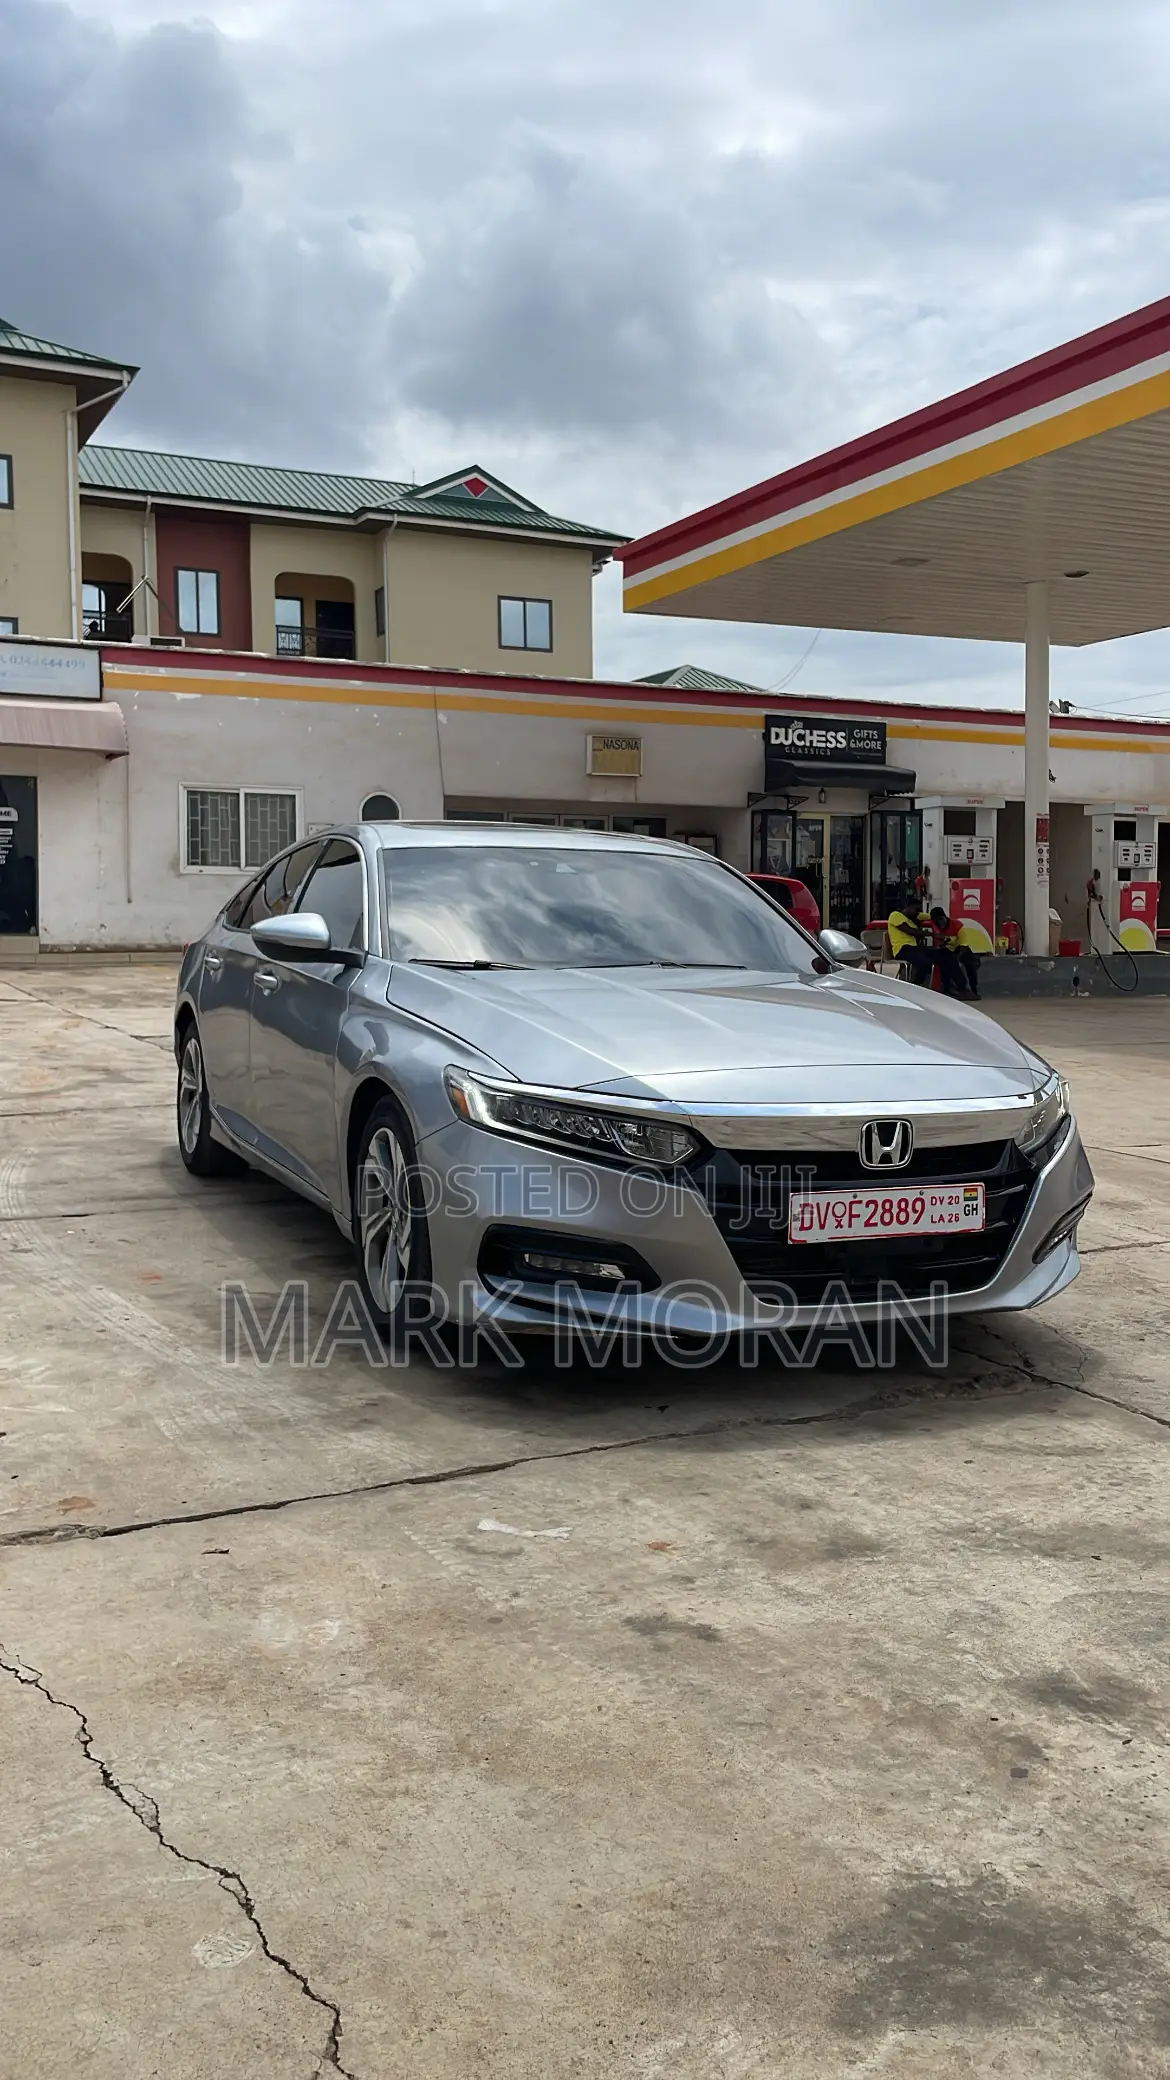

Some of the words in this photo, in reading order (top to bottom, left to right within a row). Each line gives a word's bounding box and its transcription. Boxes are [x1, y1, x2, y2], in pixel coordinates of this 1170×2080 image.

[770, 727, 847, 749] DUCHESS
[853, 729, 879, 740] GIFTS
[603, 739, 640, 751] NASONA
[849, 739, 882, 750] &MORE
[785, 747, 831, 756] CLASSICS
[931, 1196, 944, 1206] DV
[948, 1195, 960, 1205] 20
[964, 1204, 978, 1217] GH
[931, 1214, 944, 1224] LA
[948, 1213, 960, 1223] 26
